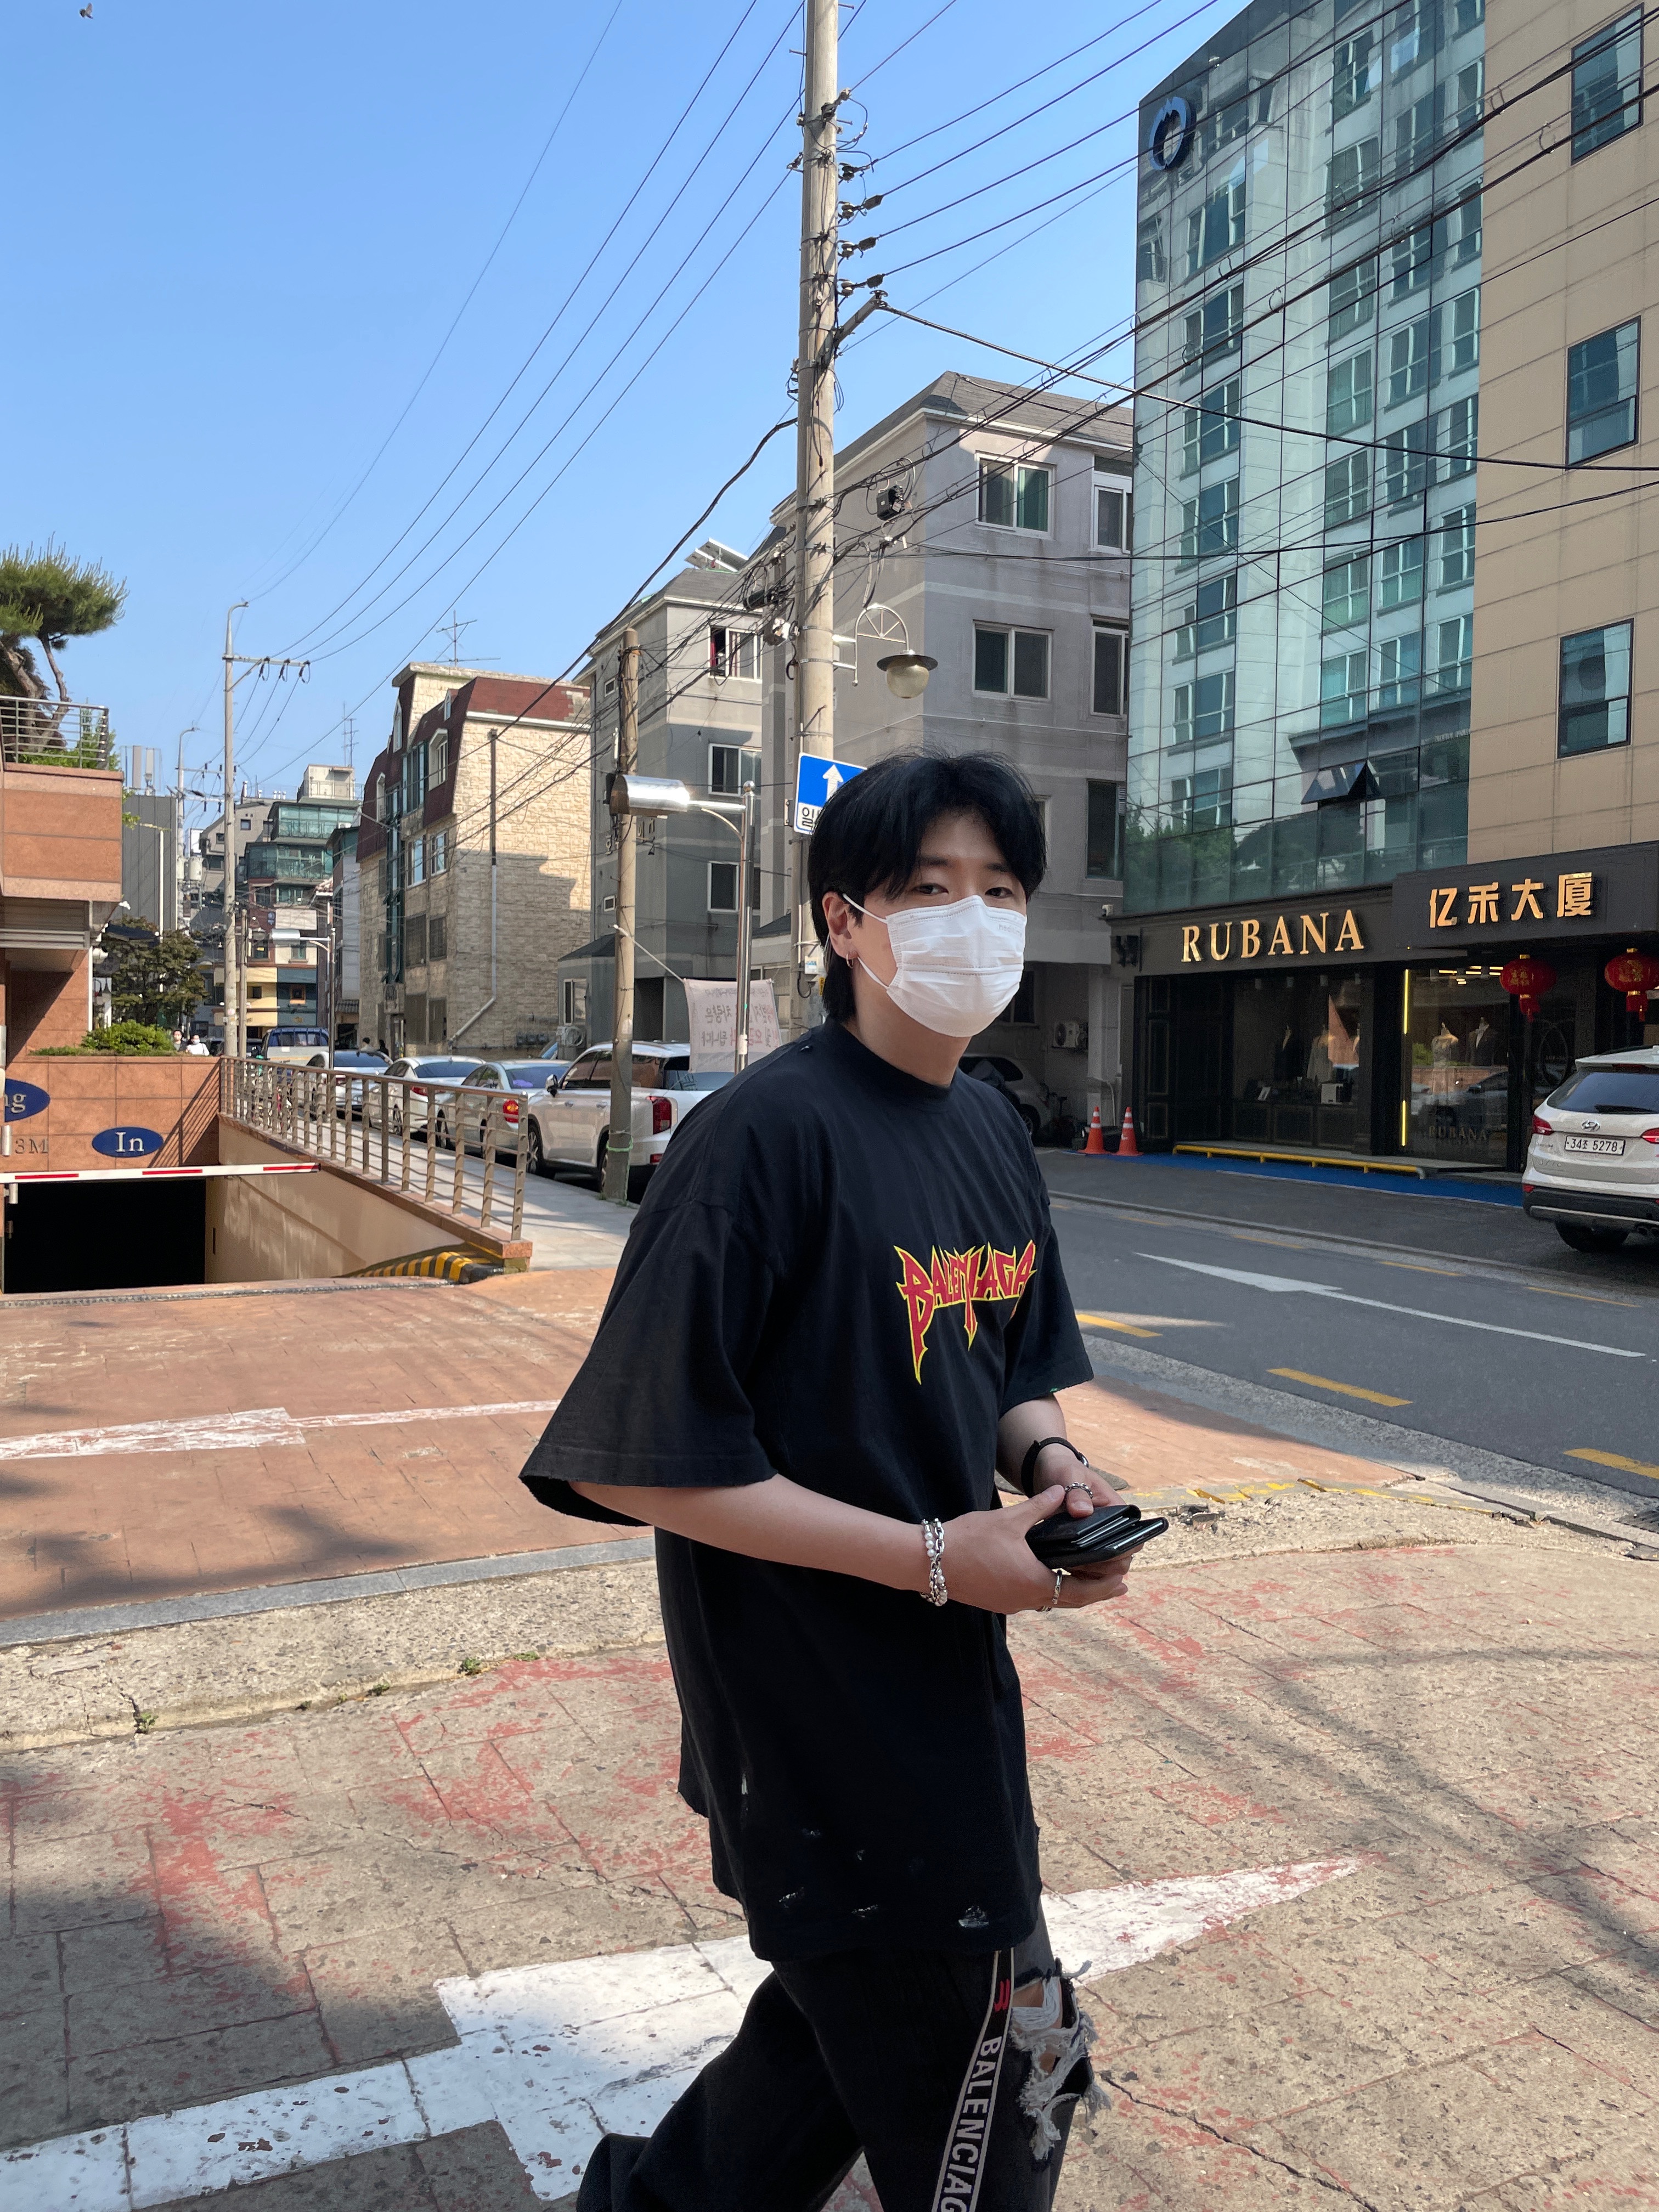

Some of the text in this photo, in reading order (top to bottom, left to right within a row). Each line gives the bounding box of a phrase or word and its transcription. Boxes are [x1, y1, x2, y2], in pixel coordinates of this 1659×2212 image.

[1429, 872, 1594, 928] 亿禾大厦
[1181, 908, 1364, 963] RUBANA
[115, 1131, 145, 1153] In
[1592, 1139, 1618, 1152] 5278
